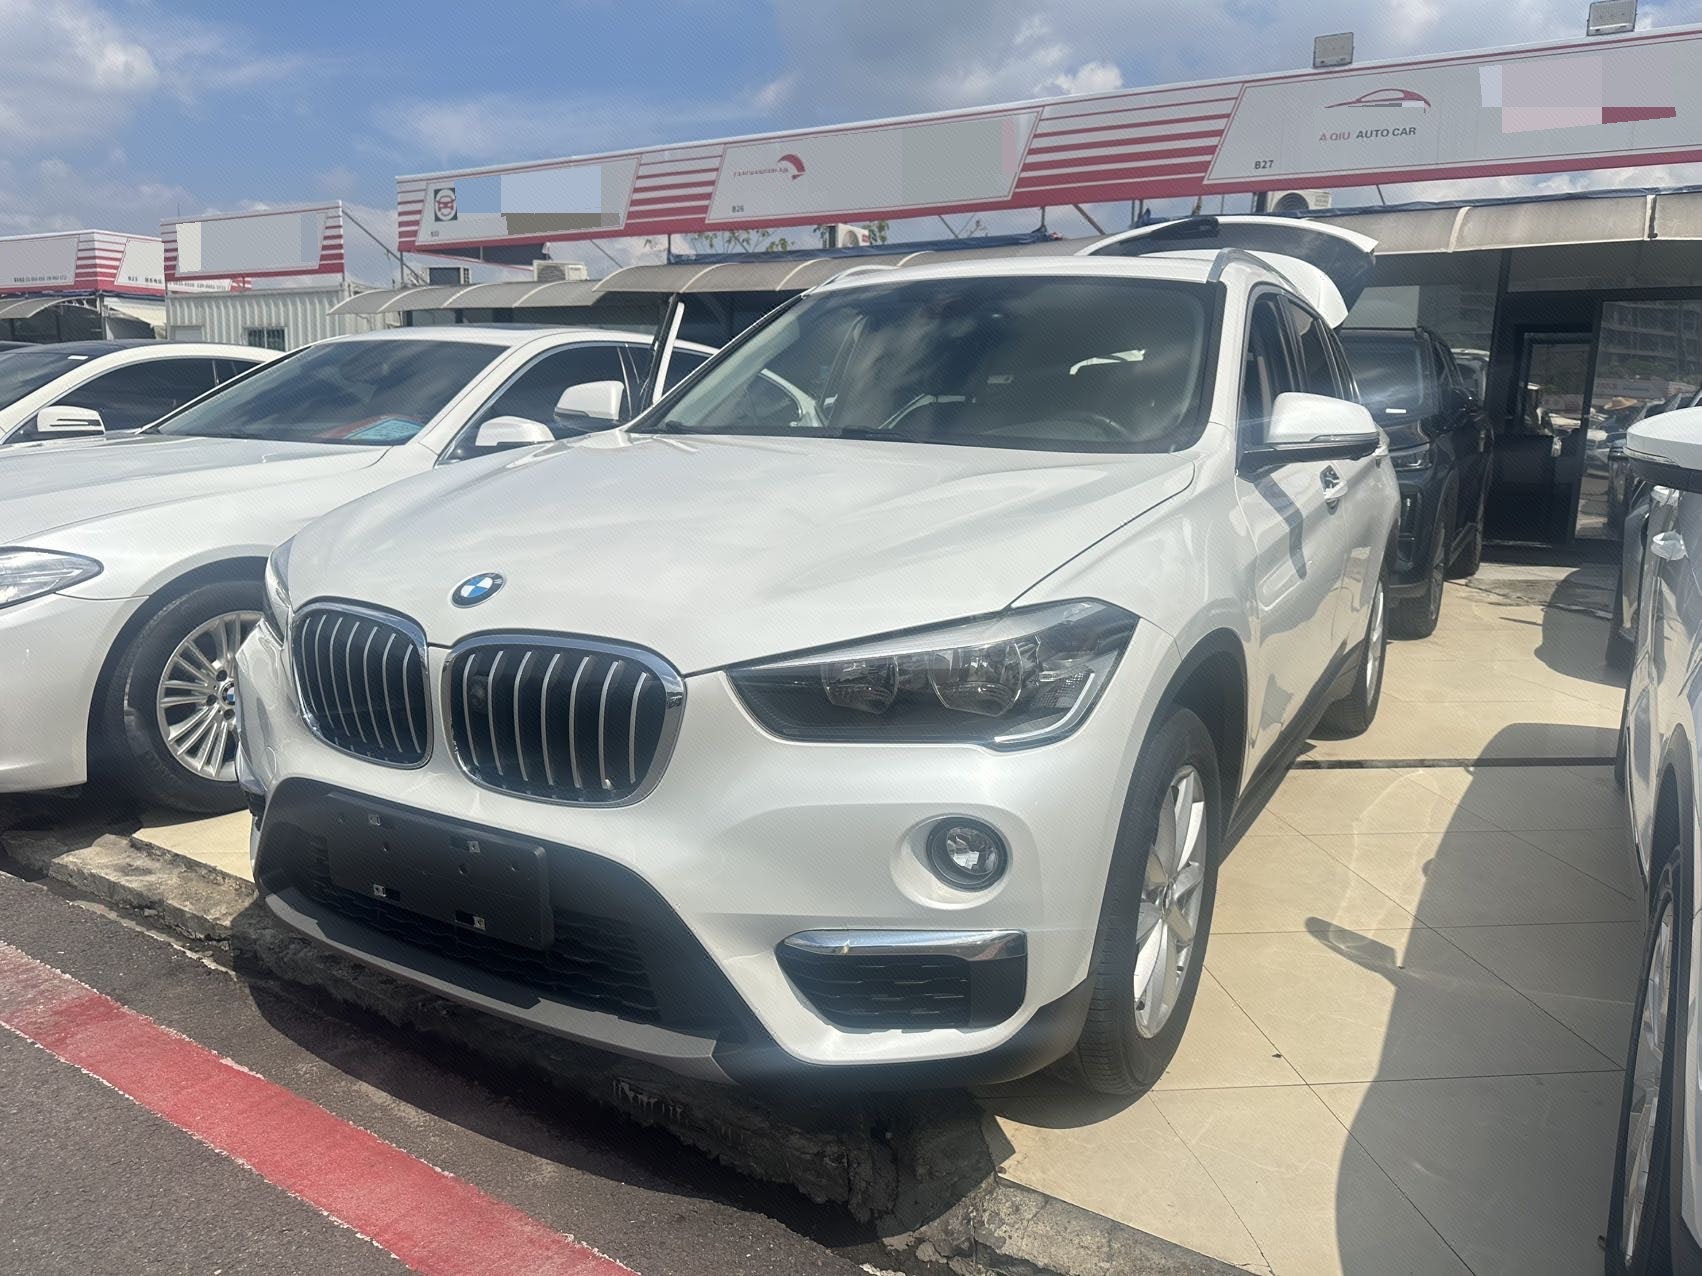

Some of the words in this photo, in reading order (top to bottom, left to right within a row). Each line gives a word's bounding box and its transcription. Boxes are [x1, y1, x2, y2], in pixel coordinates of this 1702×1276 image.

[1318, 132, 1327, 141] A
[1329, 131, 1350, 141] QIU
[1355, 128, 1389, 139] AUTO
[1392, 127, 1416, 137] CAR
[1254, 159, 1274, 170] B27
